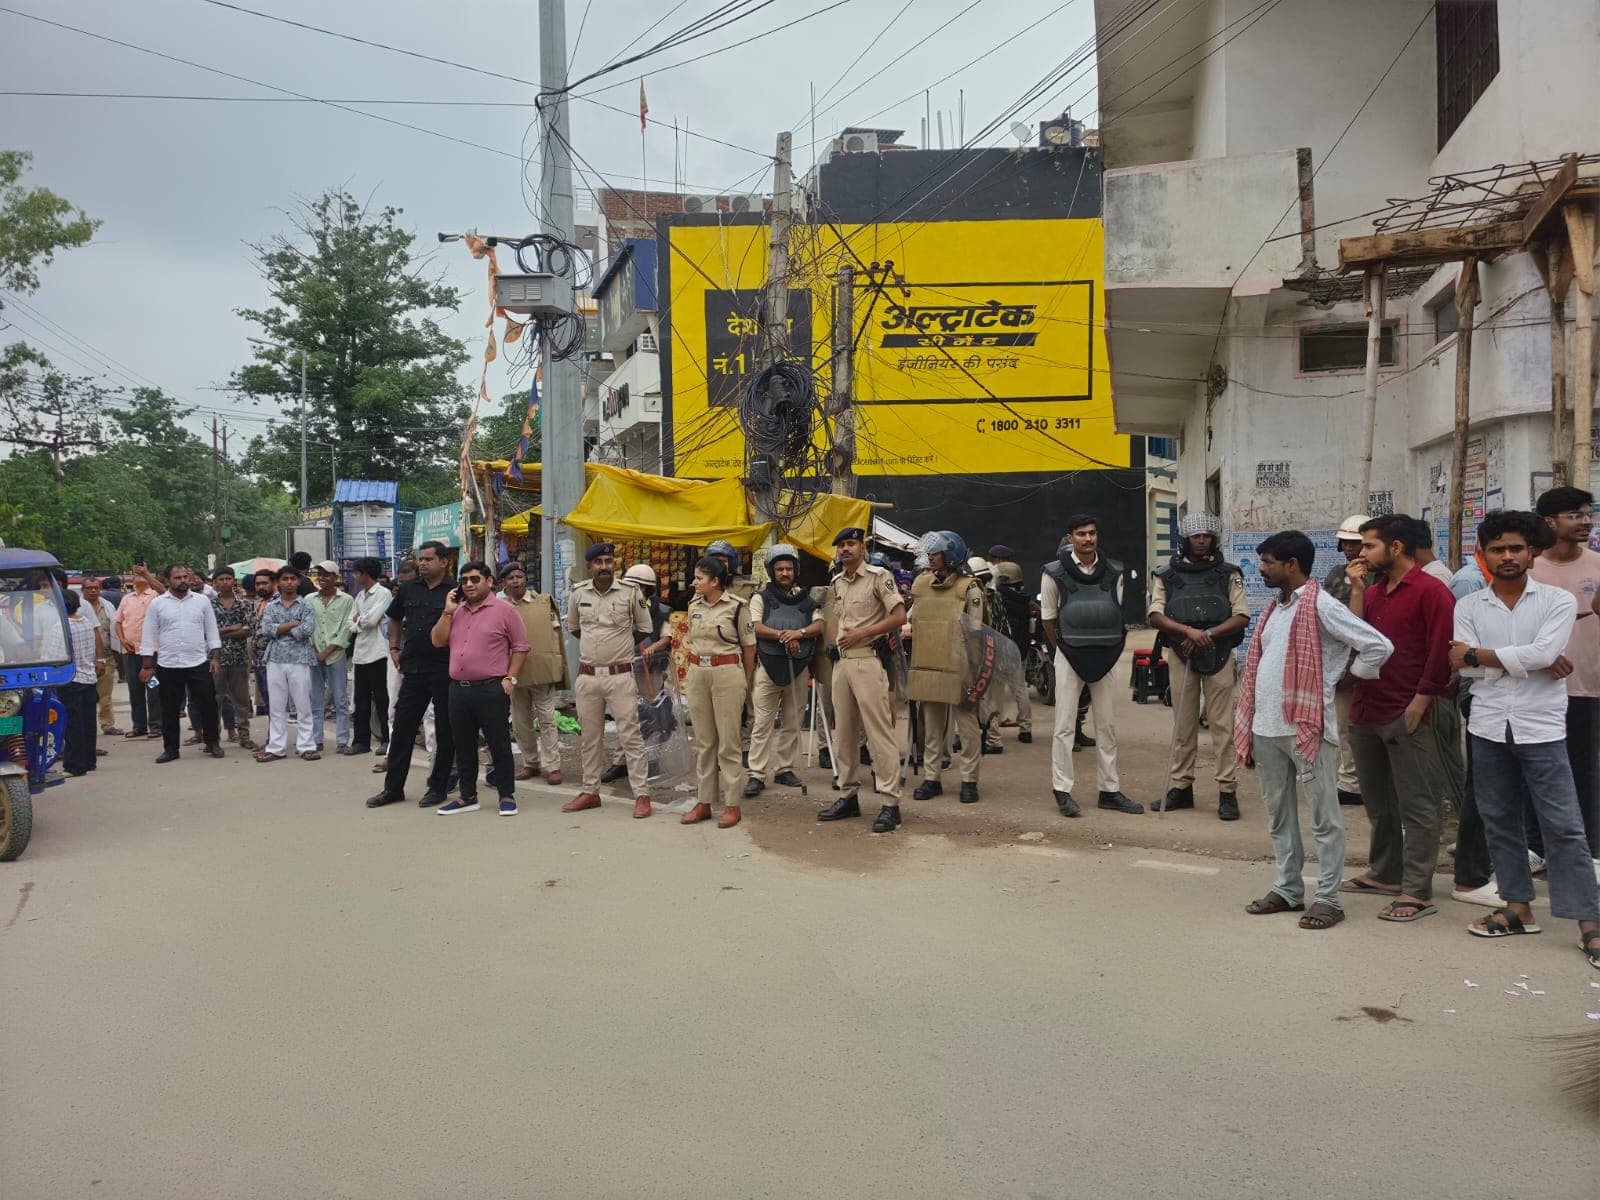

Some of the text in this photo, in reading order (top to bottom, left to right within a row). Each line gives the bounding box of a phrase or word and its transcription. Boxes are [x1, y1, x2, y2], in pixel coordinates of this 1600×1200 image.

[881, 299, 1037, 332] अल्ट्राटेक
[962, 354, 982, 369] की
[991, 418, 1081, 431] 1800 210 3311
[968, 632, 995, 703] POLICE
